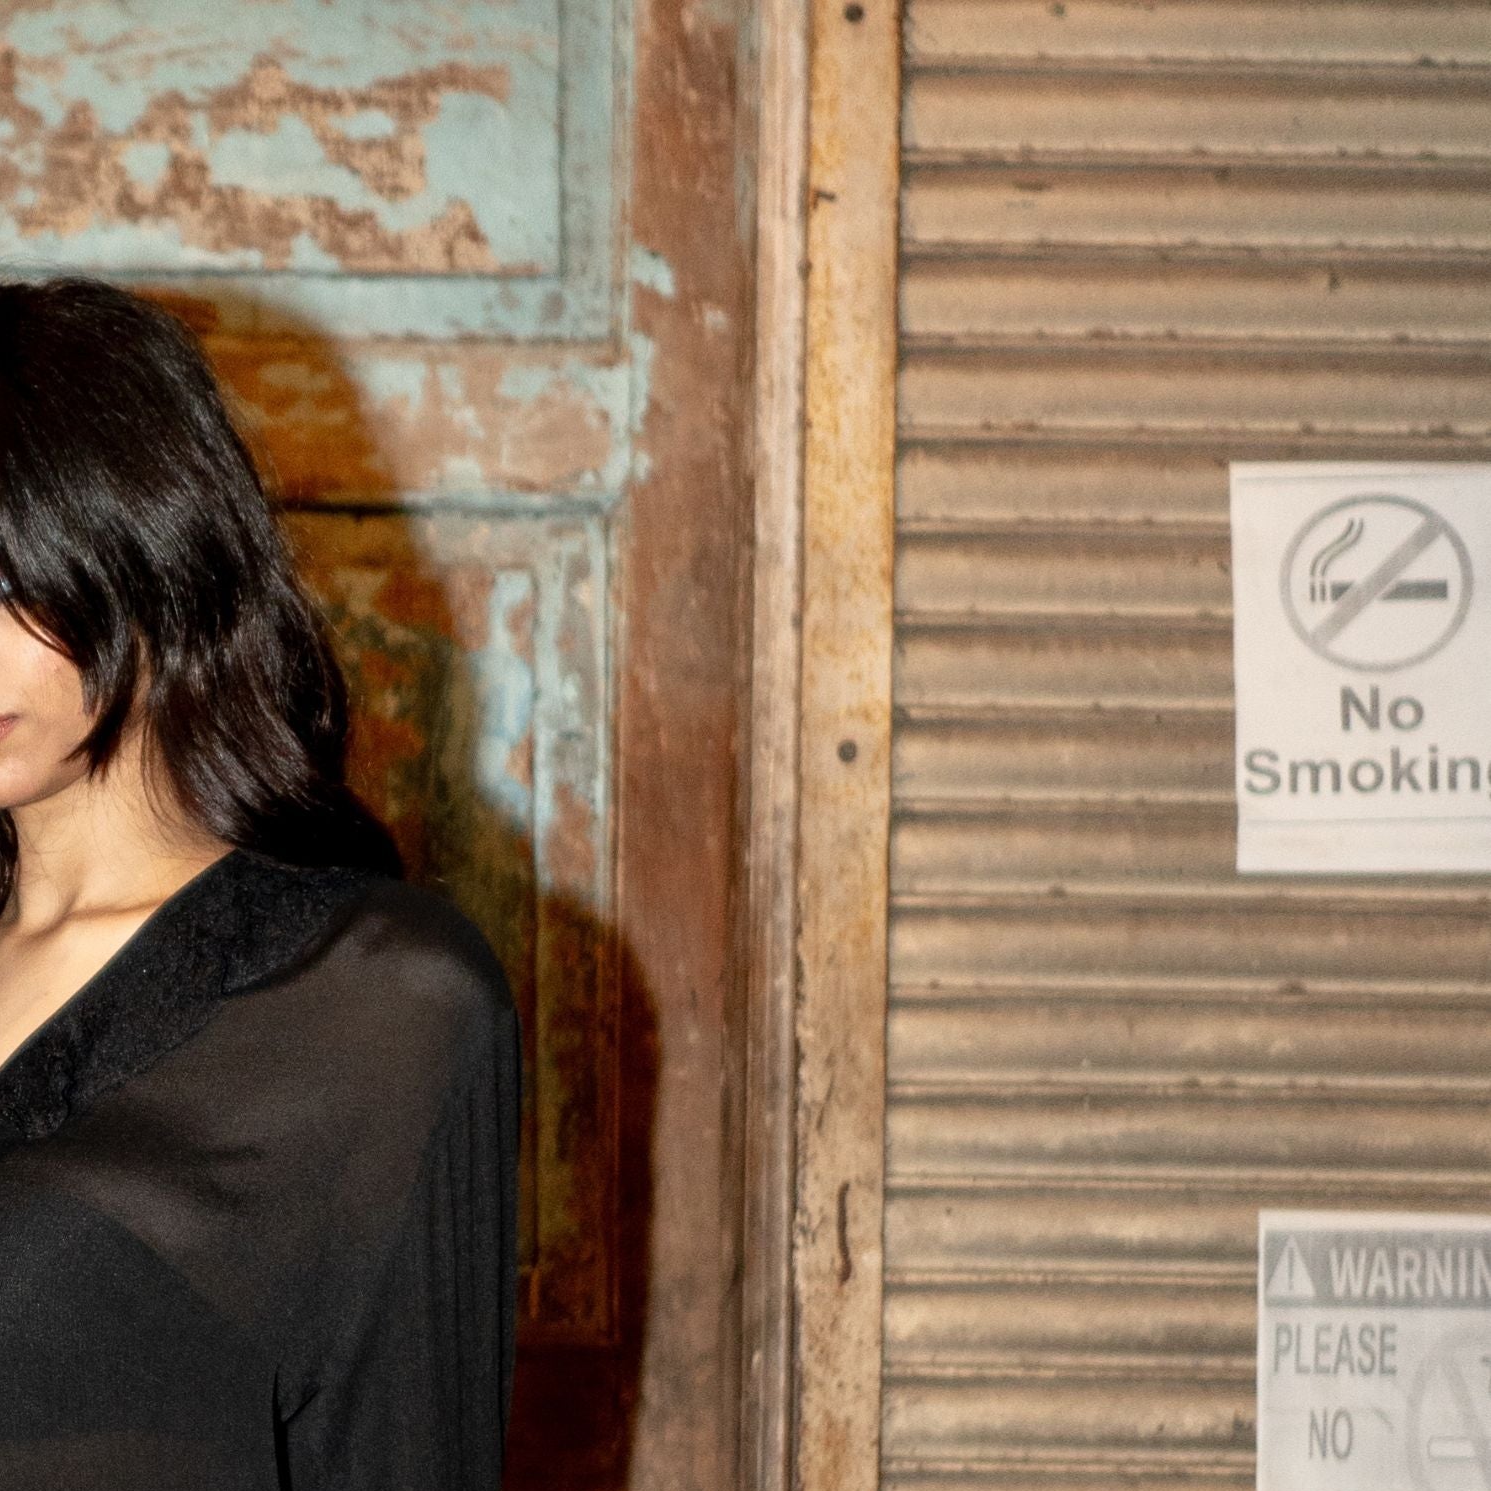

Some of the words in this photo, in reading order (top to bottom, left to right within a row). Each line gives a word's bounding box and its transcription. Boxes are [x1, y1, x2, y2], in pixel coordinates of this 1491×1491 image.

[1339, 685, 1425, 732] No
[1243, 744, 1491, 801] Smokin
[1273, 1321, 1398, 1377] PLEASE
[1308, 1407, 1353, 1460] NO
